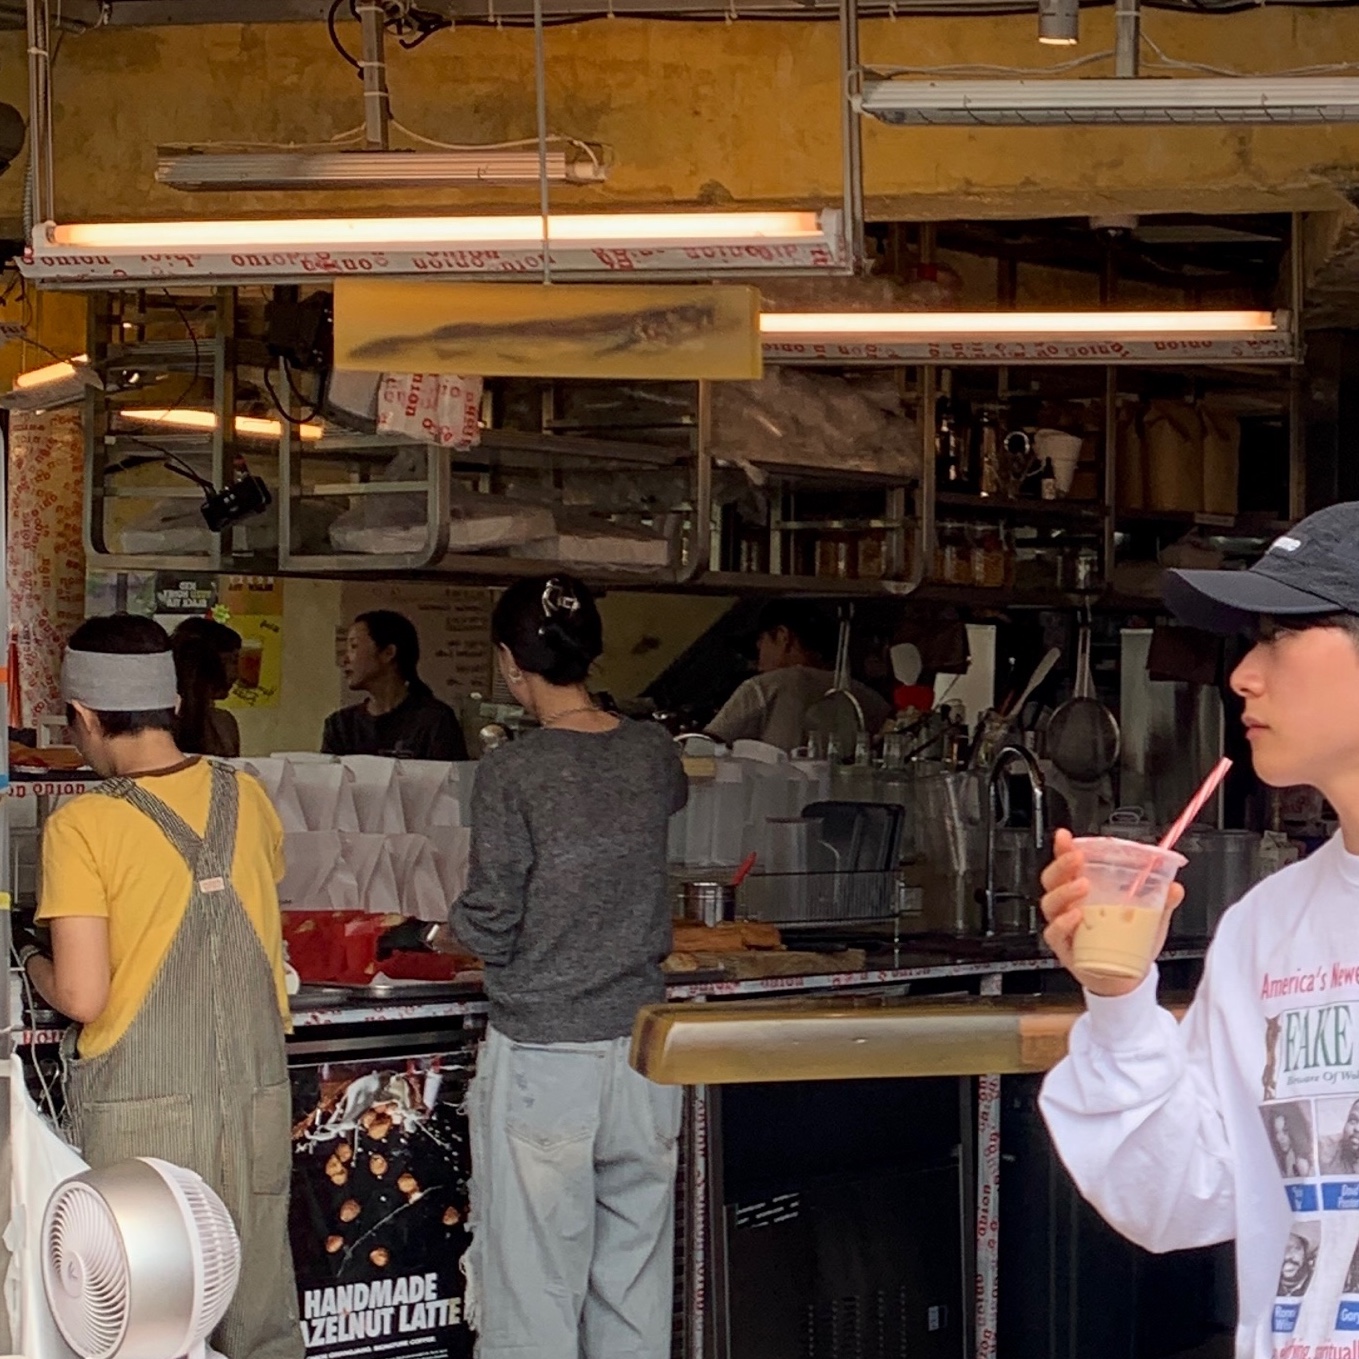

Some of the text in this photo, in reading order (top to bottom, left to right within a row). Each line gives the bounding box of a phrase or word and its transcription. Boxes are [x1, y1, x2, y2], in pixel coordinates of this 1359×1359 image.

[33, 783, 86, 796] onion
[1261, 966, 1327, 1000] America's
[1283, 1004, 1353, 1073] FAKE
[304, 1272, 438, 1320] HANDMADE
[398, 1297, 462, 1333] LATTE
